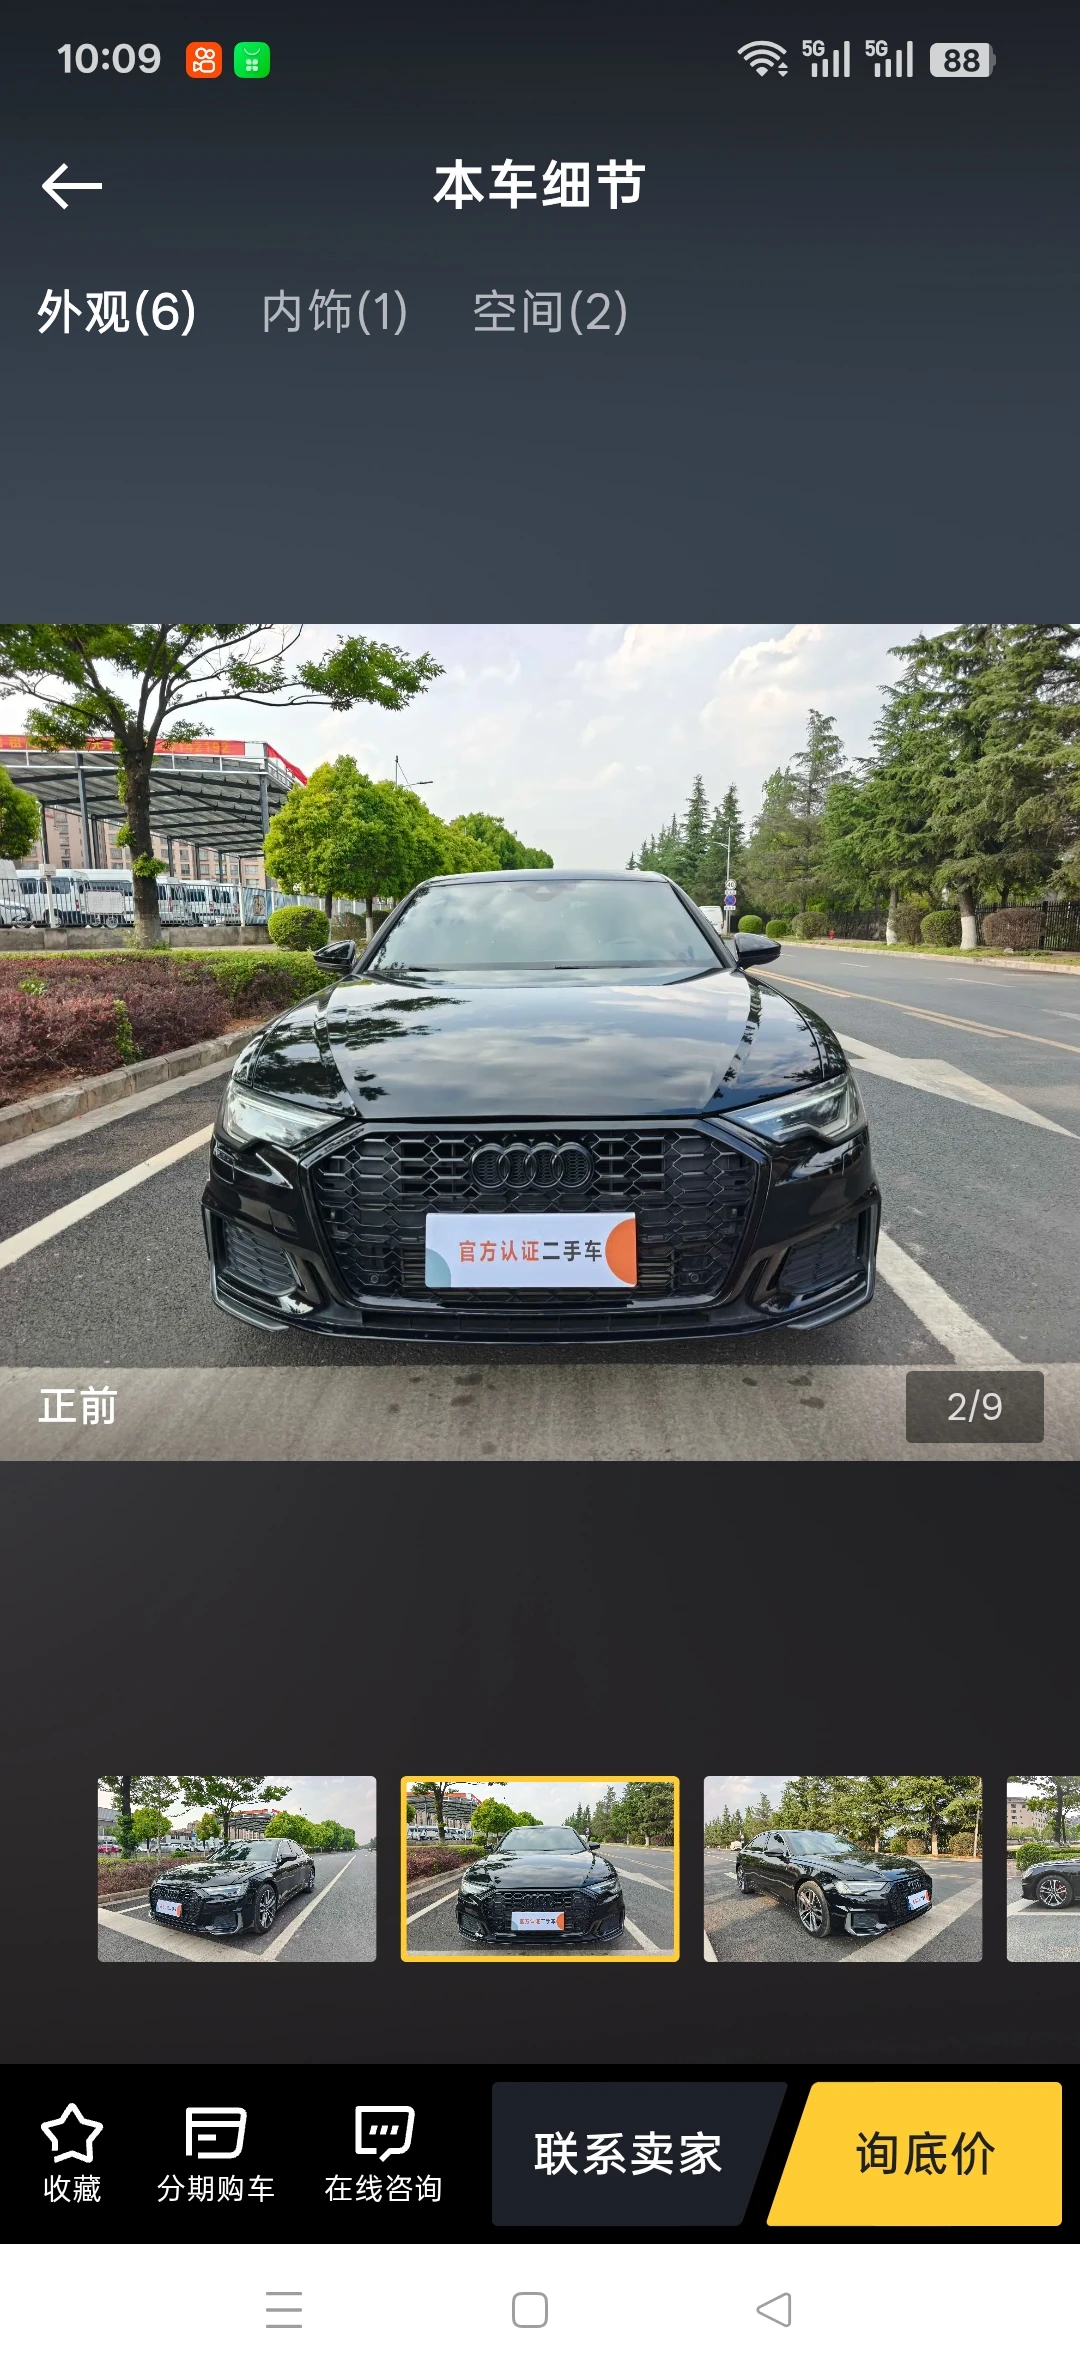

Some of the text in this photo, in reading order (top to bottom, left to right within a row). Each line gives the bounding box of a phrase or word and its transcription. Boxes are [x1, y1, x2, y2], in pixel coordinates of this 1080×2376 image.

[57, 43, 161, 74] 10:09
[801, 39, 826, 57] 5G
[864, 39, 889, 57] 5G
[943, 48, 981, 73] 88
[433, 158, 646, 210] 本车细节
[37, 288, 195, 337] 外观(6)
[263, 288, 407, 336] 内饰(1)
[473, 288, 627, 336] 空间(2)
[459, 1239, 603, 1263] 官方认证二手车
[38, 1385, 118, 1425] 正前
[947, 1388, 1003, 1423] 2/9
[533, 2130, 723, 2176] 联系卖家
[856, 2130, 996, 2176] 询底价
[43, 2173, 102, 2204] 收藏
[156, 2173, 275, 2203] 分期购车
[324, 2173, 442, 2203] 在线咨询
